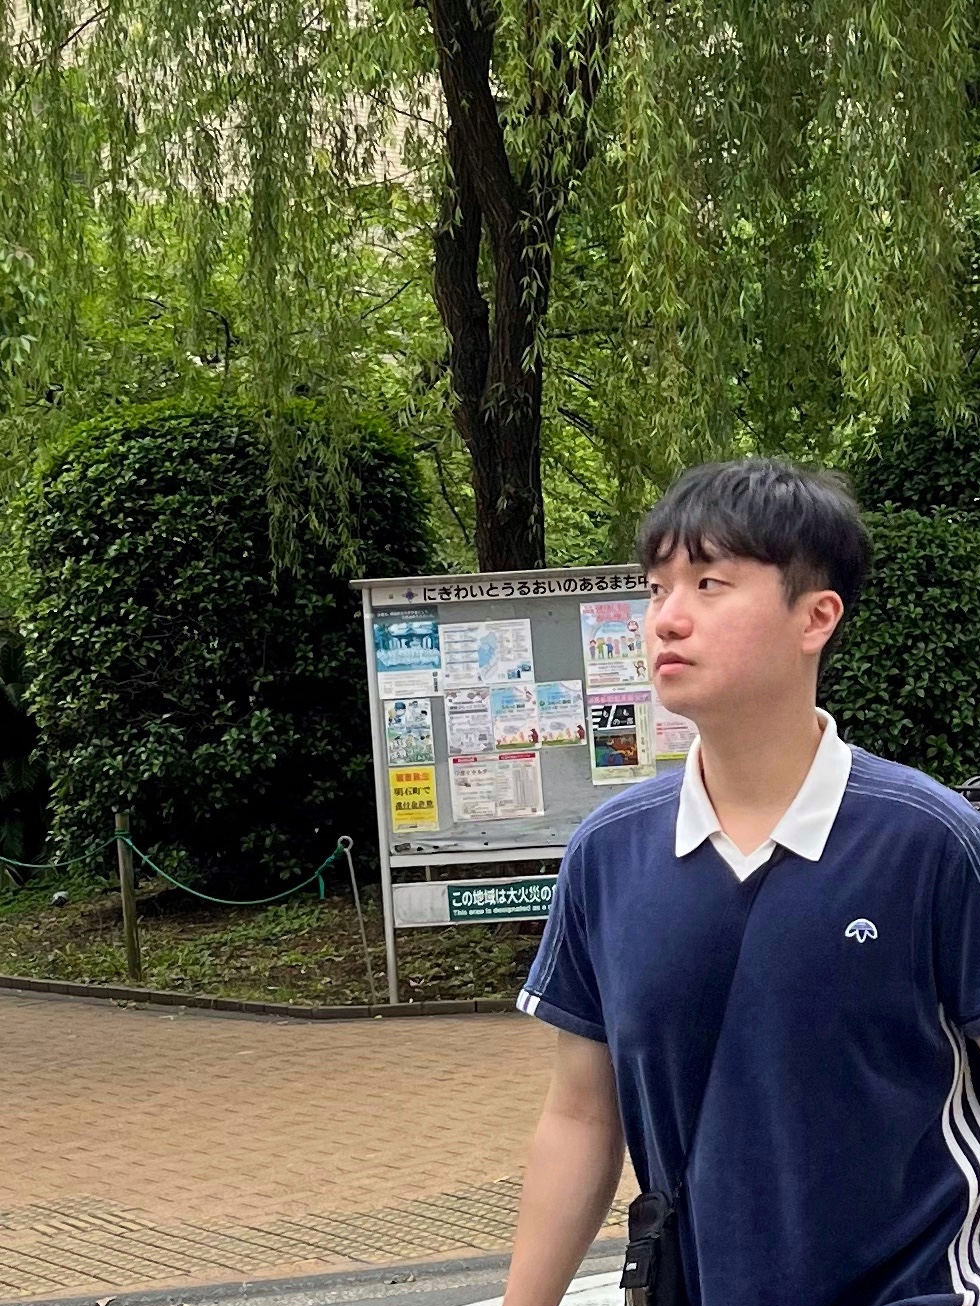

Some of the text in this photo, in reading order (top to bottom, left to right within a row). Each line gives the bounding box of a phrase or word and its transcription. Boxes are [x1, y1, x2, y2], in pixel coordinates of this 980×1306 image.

[423, 574, 649, 601] にぎわいとうるおいのあるまち中
[452, 884, 557, 907] この地域は大火災の
